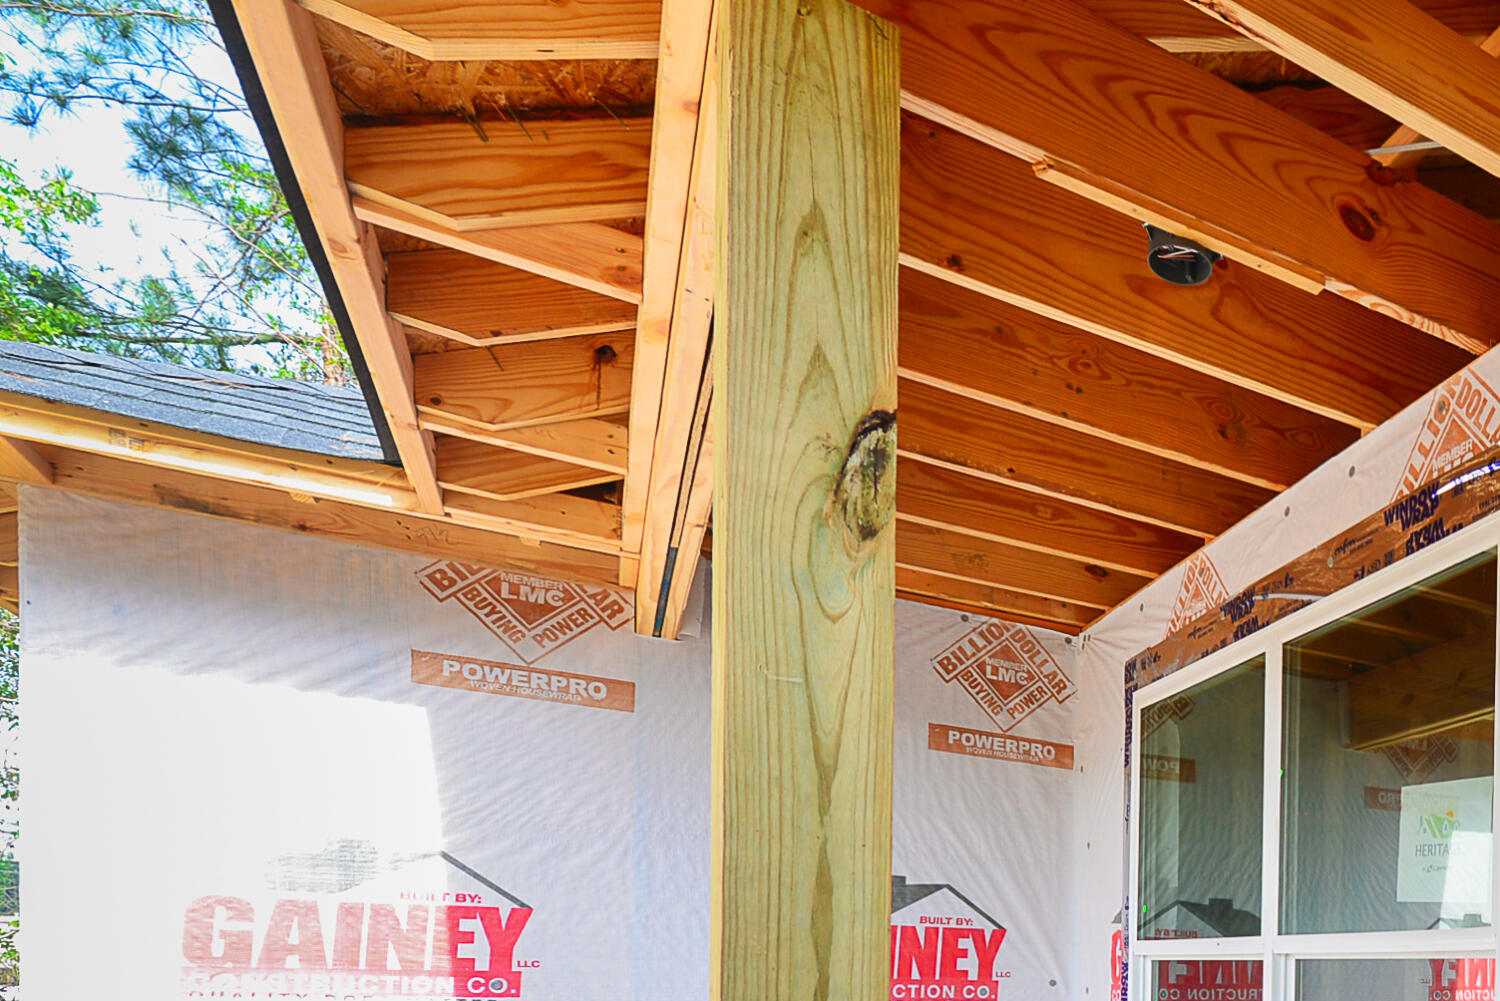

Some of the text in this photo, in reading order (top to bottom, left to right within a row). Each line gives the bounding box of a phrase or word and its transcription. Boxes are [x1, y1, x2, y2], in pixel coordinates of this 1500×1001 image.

[500, 572, 566, 591] MEMBER
[500, 582, 566, 606] LMC
[462, 587, 594, 648] BUYING POWER
[985, 666, 1029, 686] LMC
[1009, 629, 1068, 696] DOLLAR
[442, 659, 608, 701] POWERPRO
[961, 669, 1048, 721] BUYING POWER
[948, 730, 1056, 760] POWERPRO
[182, 895, 534, 971] GAINEY
[919, 915, 974, 927] BUILT BY:
[517, 960, 541, 968] LLC
[891, 925, 1007, 980] NEY
[467, 977, 517, 994] CO.
[892, 984, 996, 999] CTION CO.
